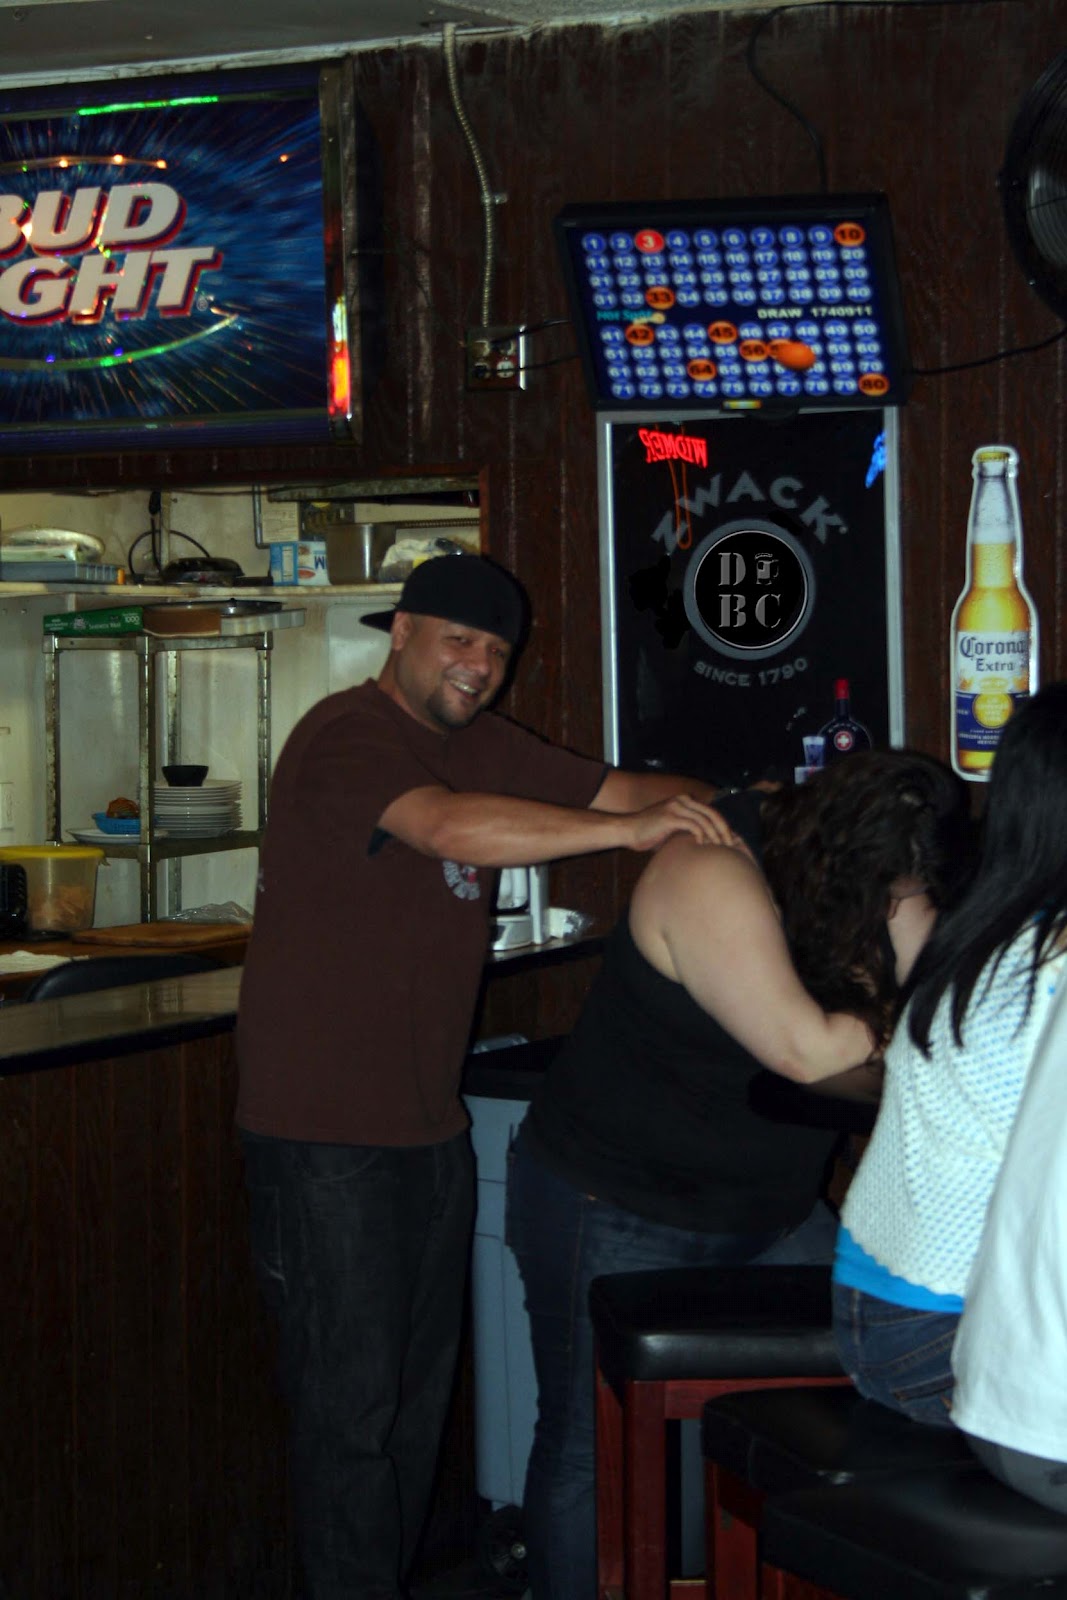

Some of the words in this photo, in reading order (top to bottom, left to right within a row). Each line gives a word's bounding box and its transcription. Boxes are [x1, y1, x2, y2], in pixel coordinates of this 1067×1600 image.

[839, 229, 861, 240] 10
[587, 257, 606, 267] 11
[614, 256, 633, 266] 12
[643, 255, 661, 266] 13
[671, 254, 689, 265] 14
[700, 253, 717, 264] 15
[729, 253, 746, 263] 16
[757, 252, 774, 262] 17
[785, 251, 802, 261] 18
[814, 250, 831, 260] 19
[841, 248, 864, 259] 20
[0, 246, 220, 322] GHT
[757, 308, 803, 319] DRAW
[650, 470, 844, 553] ZWACK
[959, 635, 1026, 661] Corona
[693, 660, 751, 687] SINCE
[758, 657, 808, 686] 1790
[975, 658, 1016, 672] Extra
